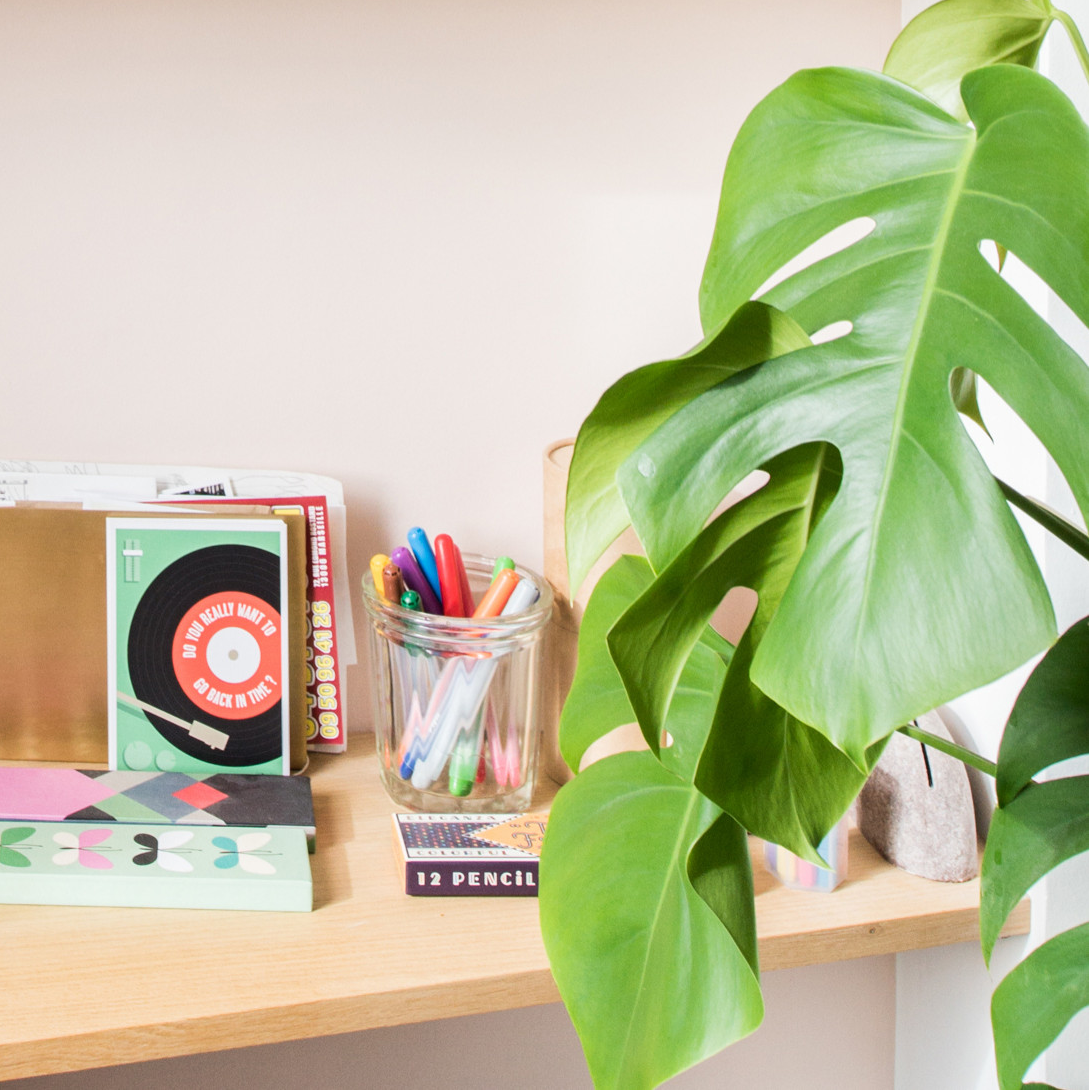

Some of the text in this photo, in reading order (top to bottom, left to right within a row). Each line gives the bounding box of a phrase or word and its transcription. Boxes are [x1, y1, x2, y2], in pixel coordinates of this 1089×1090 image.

[315, 506, 327, 556] MARSEILLE
[312, 600, 331, 628] 26
[182, 602, 277, 659] DO YOU REALLY WANT TO
[313, 629, 333, 653] 41
[315, 654, 335, 682] 96
[193, 677, 273, 709] GO BACK IN TIME
[317, 683, 337, 710] 50
[319, 711, 340, 740] 09
[417, 871, 442, 886] 12
